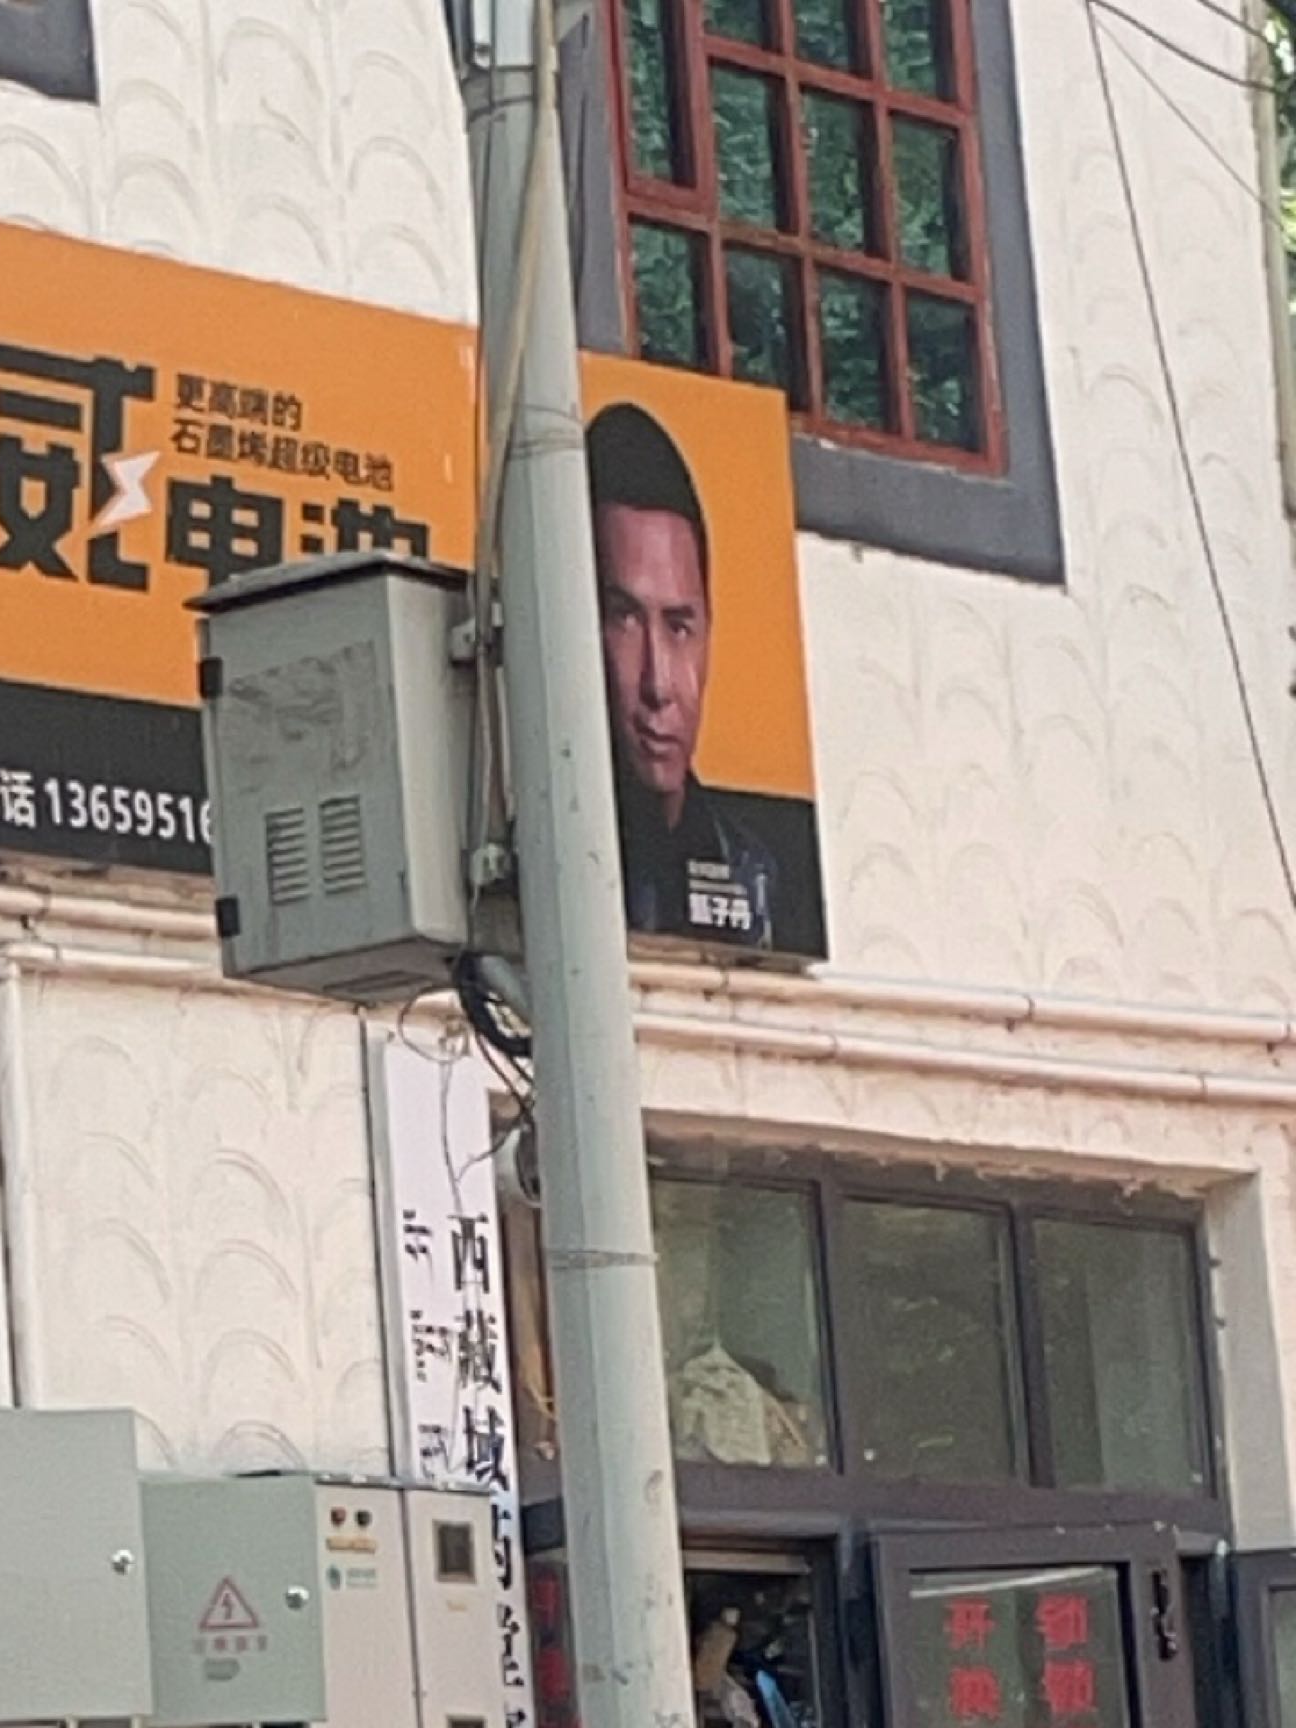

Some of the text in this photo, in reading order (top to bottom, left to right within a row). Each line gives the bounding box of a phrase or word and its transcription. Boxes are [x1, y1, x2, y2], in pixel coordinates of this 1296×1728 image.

[175, 373, 303, 432] 更高端的
[170, 418, 394, 491] 石墨烯超级电池
